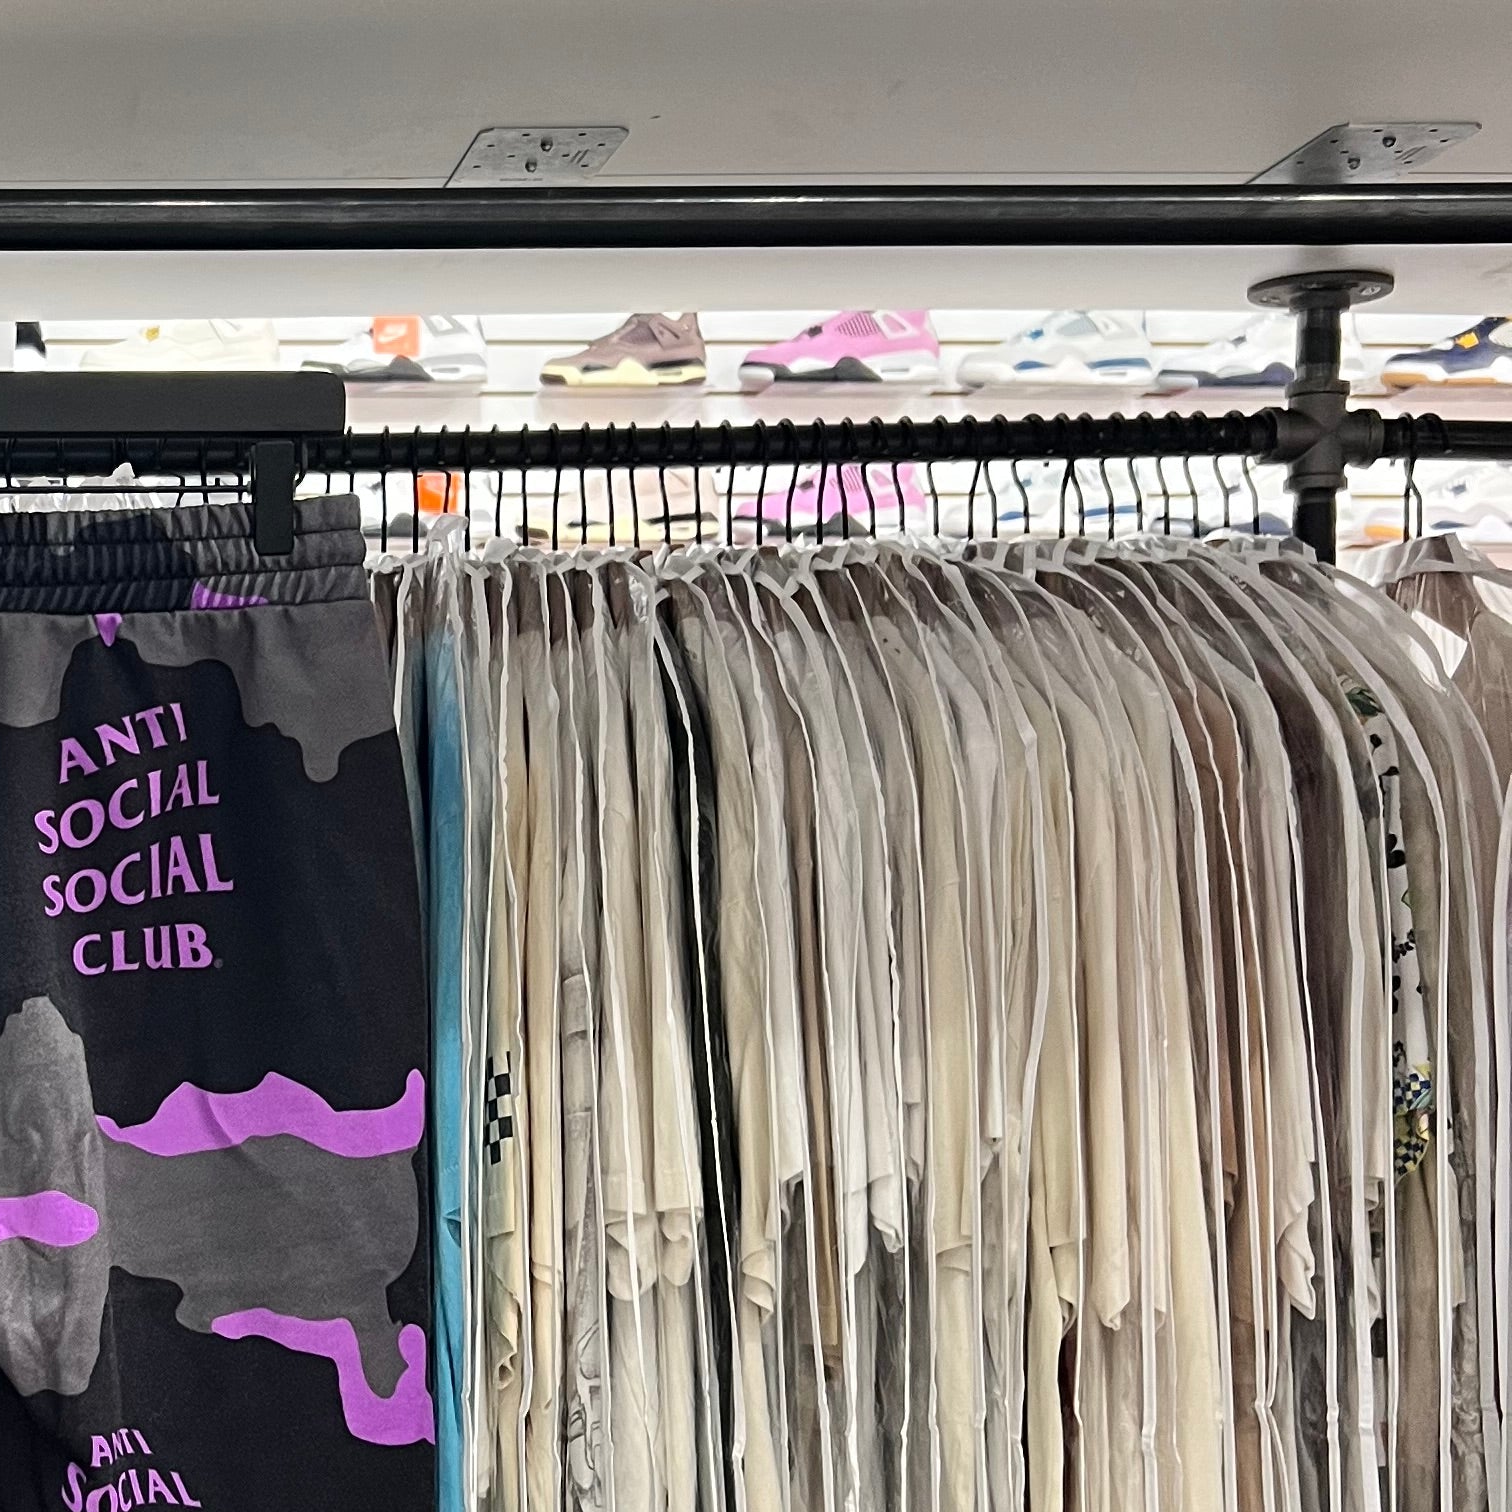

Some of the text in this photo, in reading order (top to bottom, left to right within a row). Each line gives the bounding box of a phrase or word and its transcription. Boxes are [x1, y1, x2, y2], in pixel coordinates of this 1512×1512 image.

[59, 702, 187, 784] ANTI
[34, 760, 220, 854] SOCIAL
[42, 833, 234, 917] SOCIAL
[90, 1427, 154, 1468] ANTI
